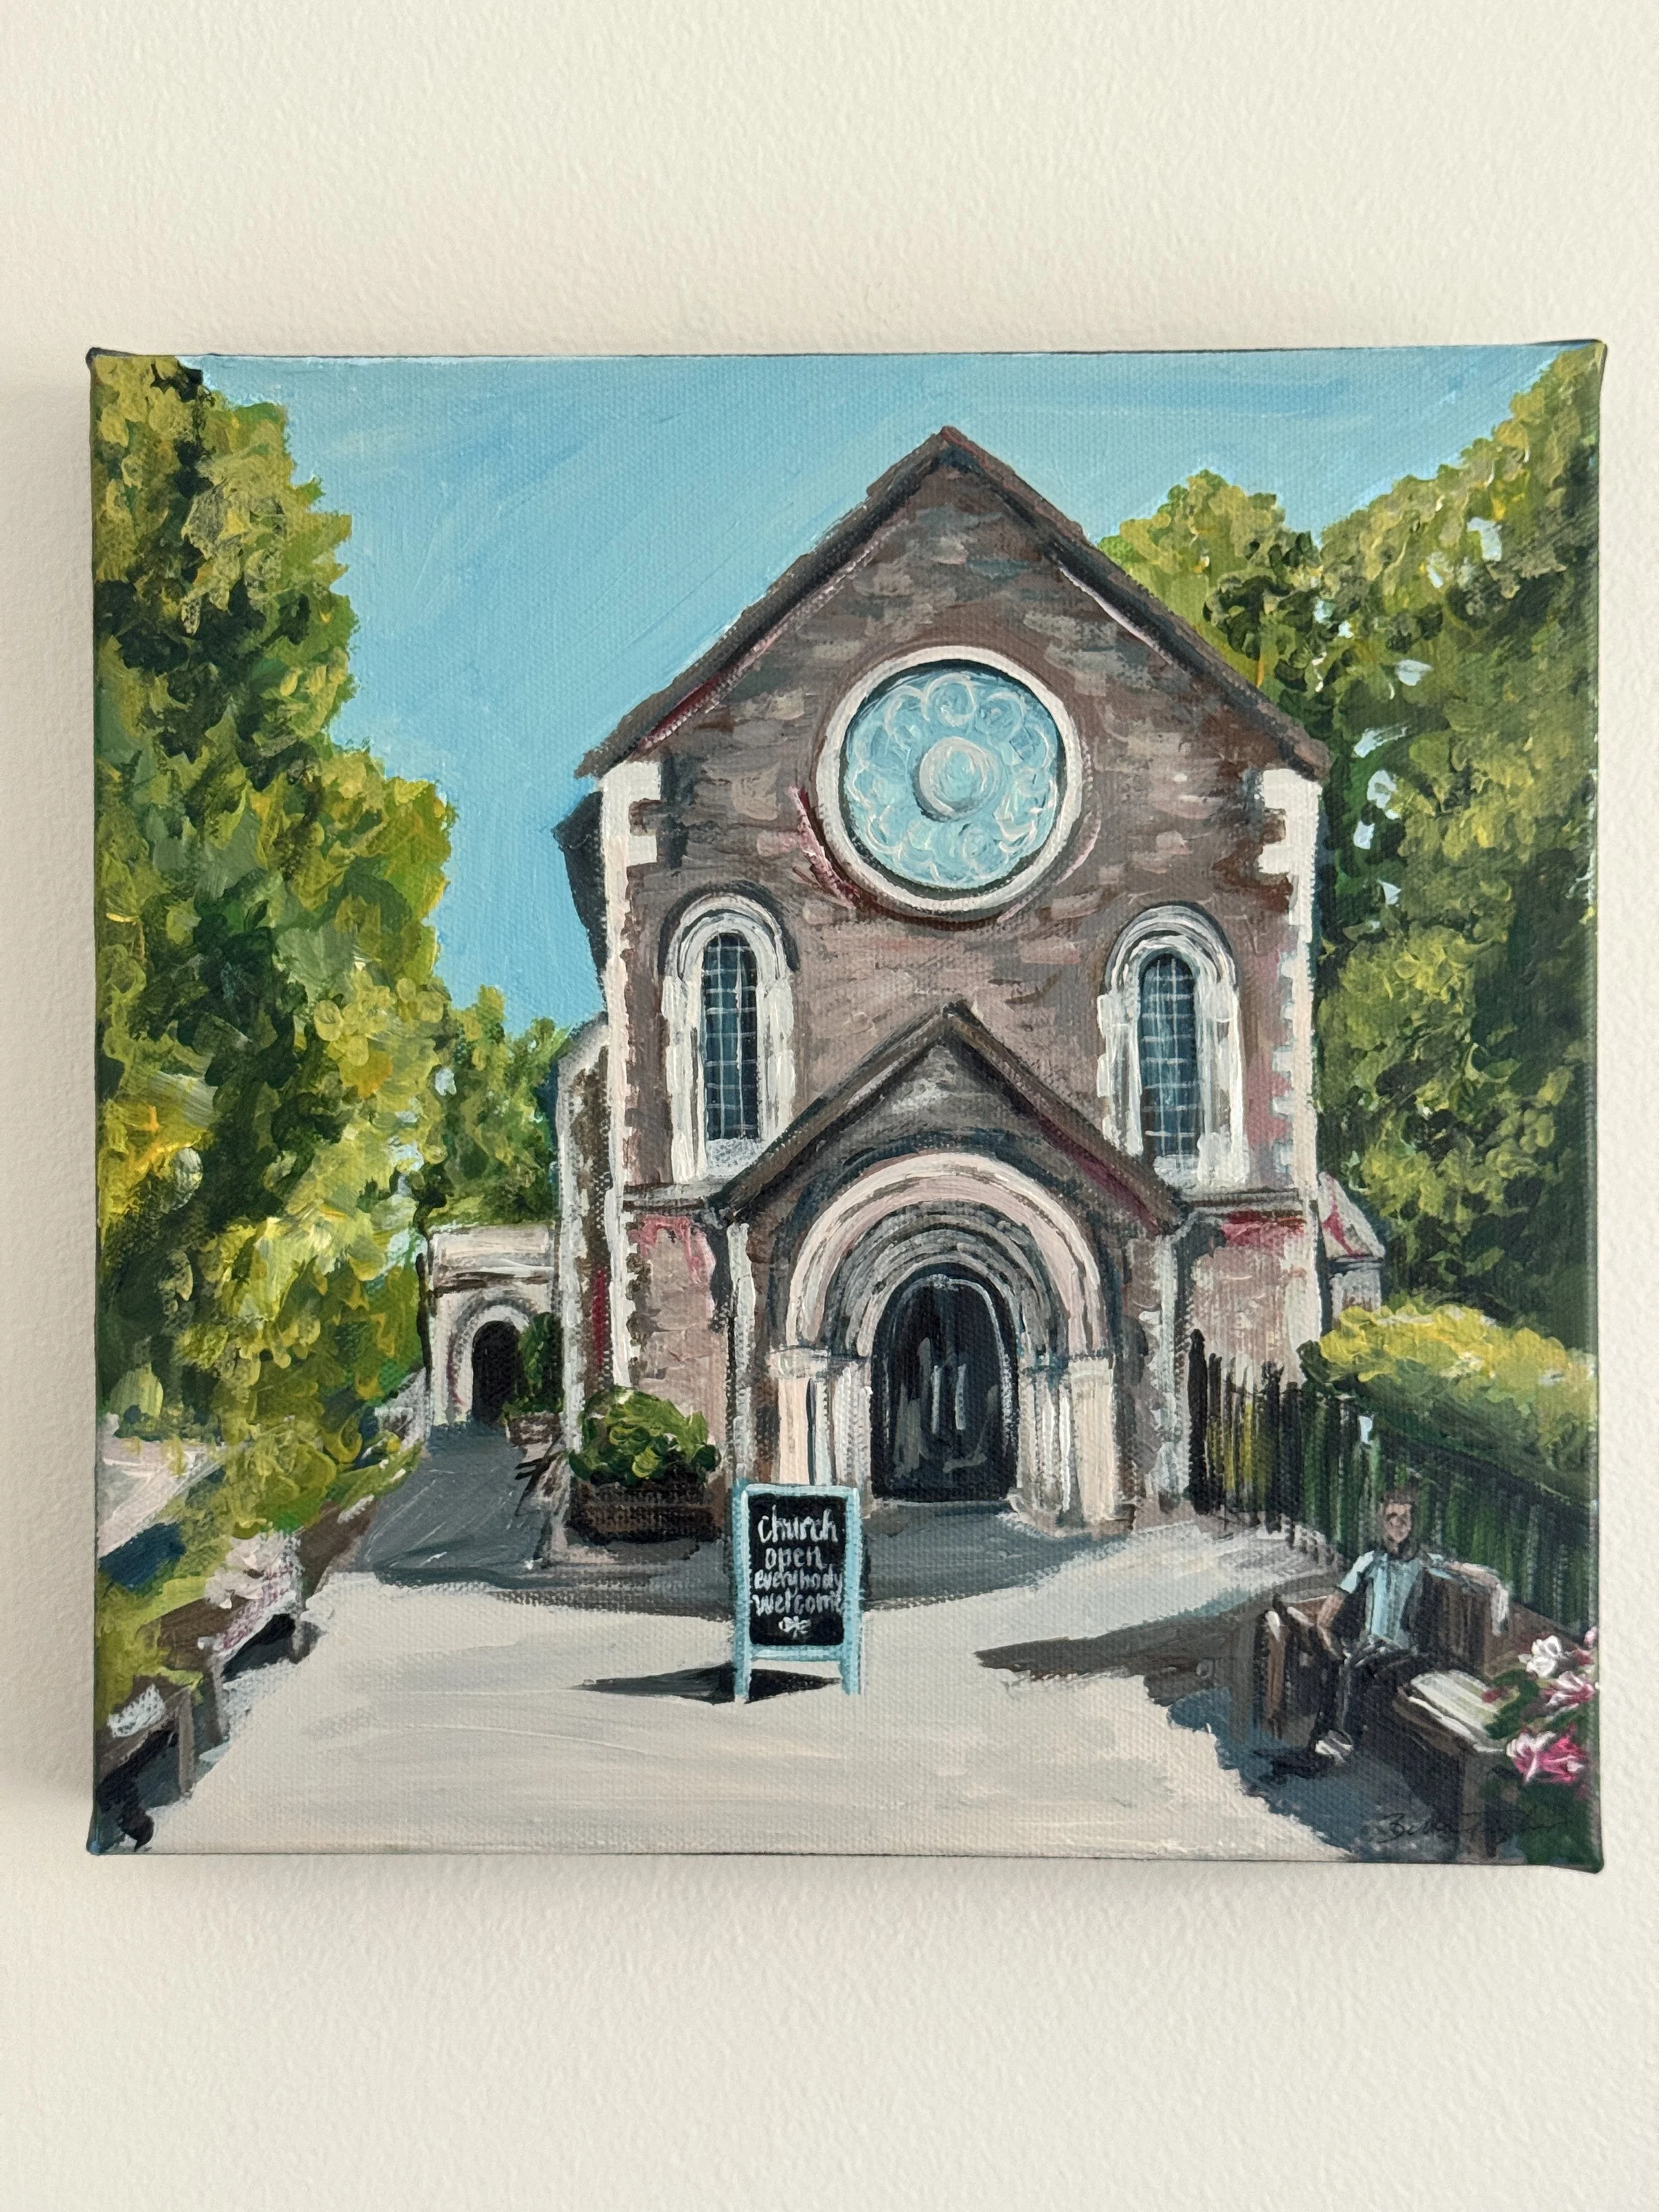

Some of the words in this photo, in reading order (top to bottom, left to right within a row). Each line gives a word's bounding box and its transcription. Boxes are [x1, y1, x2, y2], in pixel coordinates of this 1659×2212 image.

[764, 1547, 827, 1573] open
[754, 1564, 843, 1597] everybody
[752, 1589, 844, 1615] welcome
